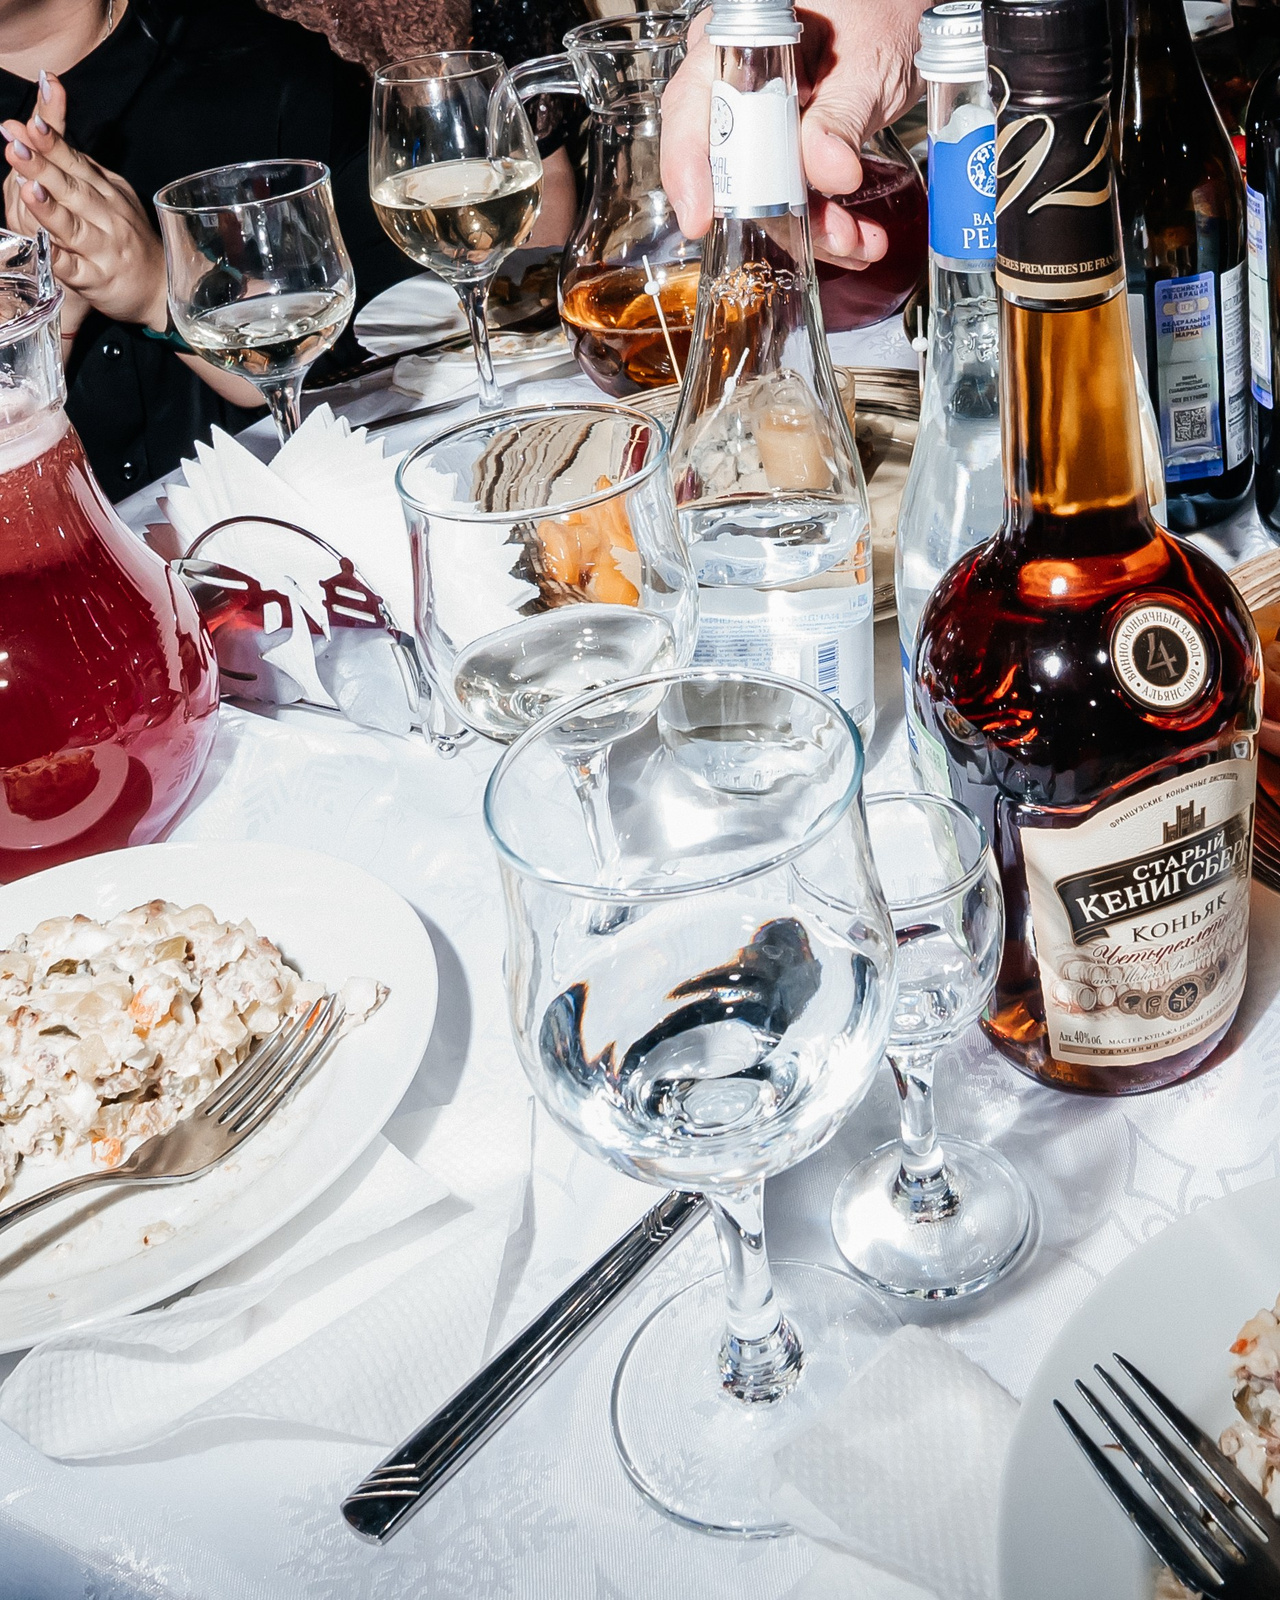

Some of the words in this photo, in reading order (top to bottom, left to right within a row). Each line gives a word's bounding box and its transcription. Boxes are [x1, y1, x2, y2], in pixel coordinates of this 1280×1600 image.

[713, 176, 732, 194] RVE
[962, 228, 996, 250] PE
[1020, 261, 1078, 276] PREMIERES
[1079, 260, 1094, 274] DE
[1175, 330, 1200, 338] МАРКА
[1118, 611, 1180, 682] ВИННО-КОНЬЯЧНЫЙ
[1179, 624, 1201, 658] ЗАВОД
[1146, 632, 1179, 678] 4
[1109, 796, 1164, 828] ФРАНЦУЗСКИЕ
[1165, 777, 1207, 799] КОНЬЯЧНЫЕ
[1132, 830, 1225, 881] СТАРЫЙ
[1132, 890, 1228, 942] КОНЬЯК
[1074, 1030, 1090, 1044] 40%
[1108, 1036, 1142, 1045] МАСТЕР
[1092, 1042, 1159, 1055] ПОДЛИННЫЙ
